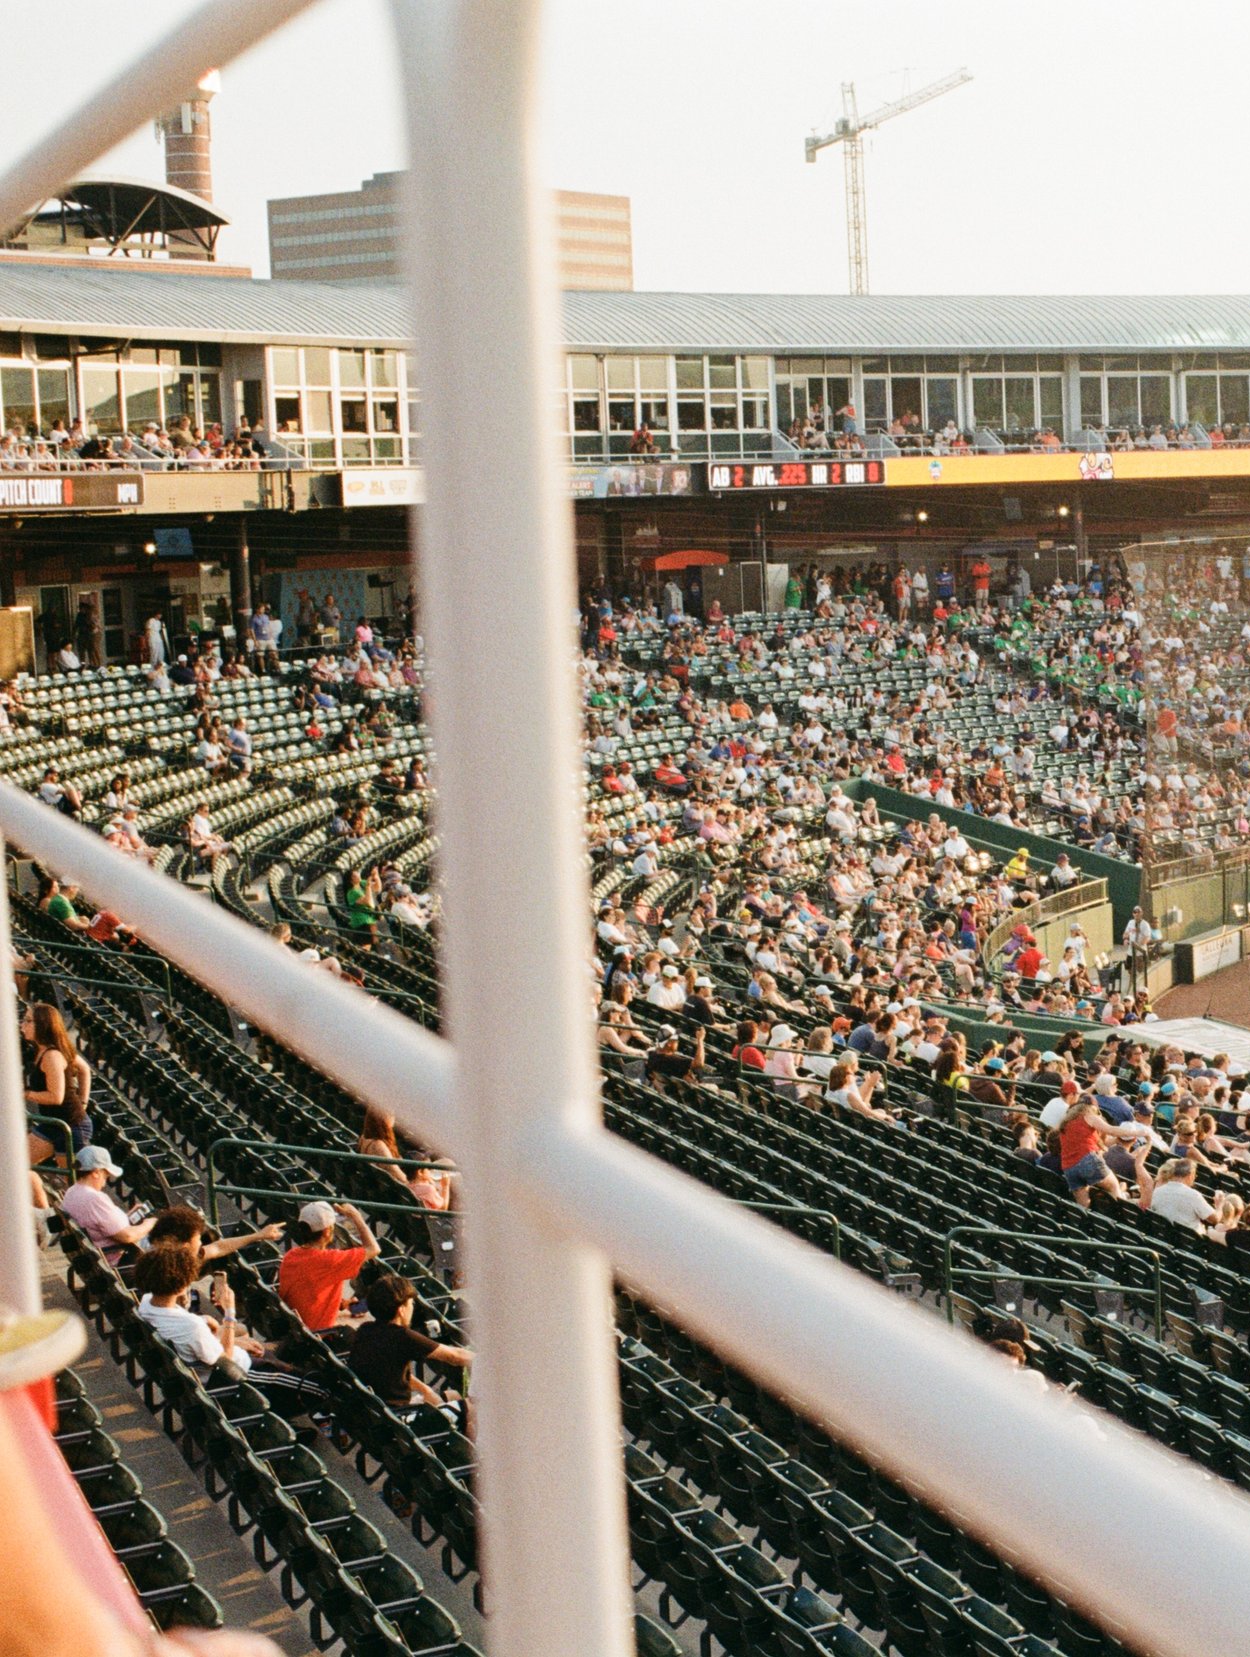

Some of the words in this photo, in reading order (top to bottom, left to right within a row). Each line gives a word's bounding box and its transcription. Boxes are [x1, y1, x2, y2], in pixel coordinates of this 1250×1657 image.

[712, 466, 731, 488] AB
[734, 466, 744, 488] 2
[812, 464, 828, 485] HR
[832, 463, 841, 484] 2
[845, 463, 865, 484] RBI
[28, 479, 63, 505] COUNT
